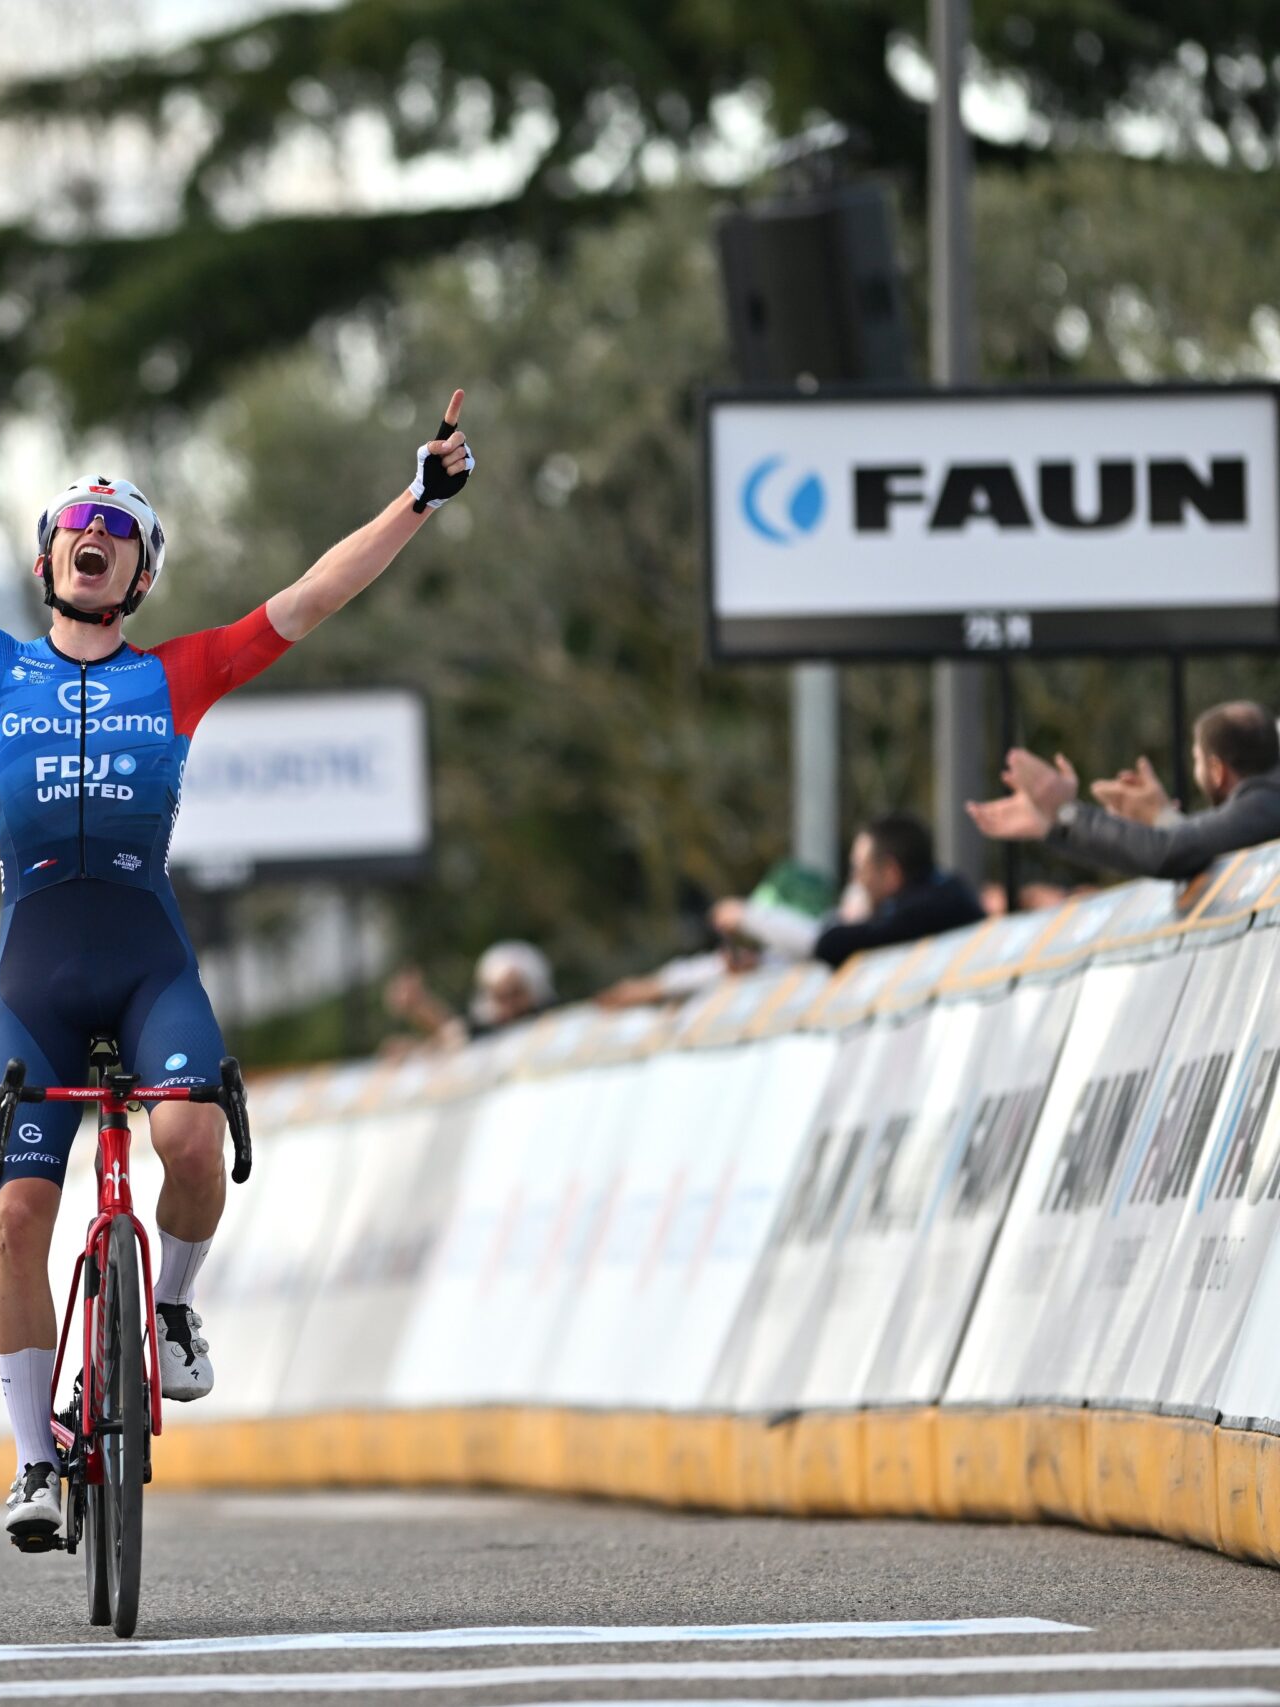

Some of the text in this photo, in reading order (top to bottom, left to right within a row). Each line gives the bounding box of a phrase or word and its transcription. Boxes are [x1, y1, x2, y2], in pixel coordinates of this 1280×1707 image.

[852, 457, 1247, 534] FAUN
[19, 656, 56, 669] BIORACER
[2, 713, 167, 739] Groupama
[35, 754, 110, 782] FDJ
[37, 782, 134, 803] UNITED
